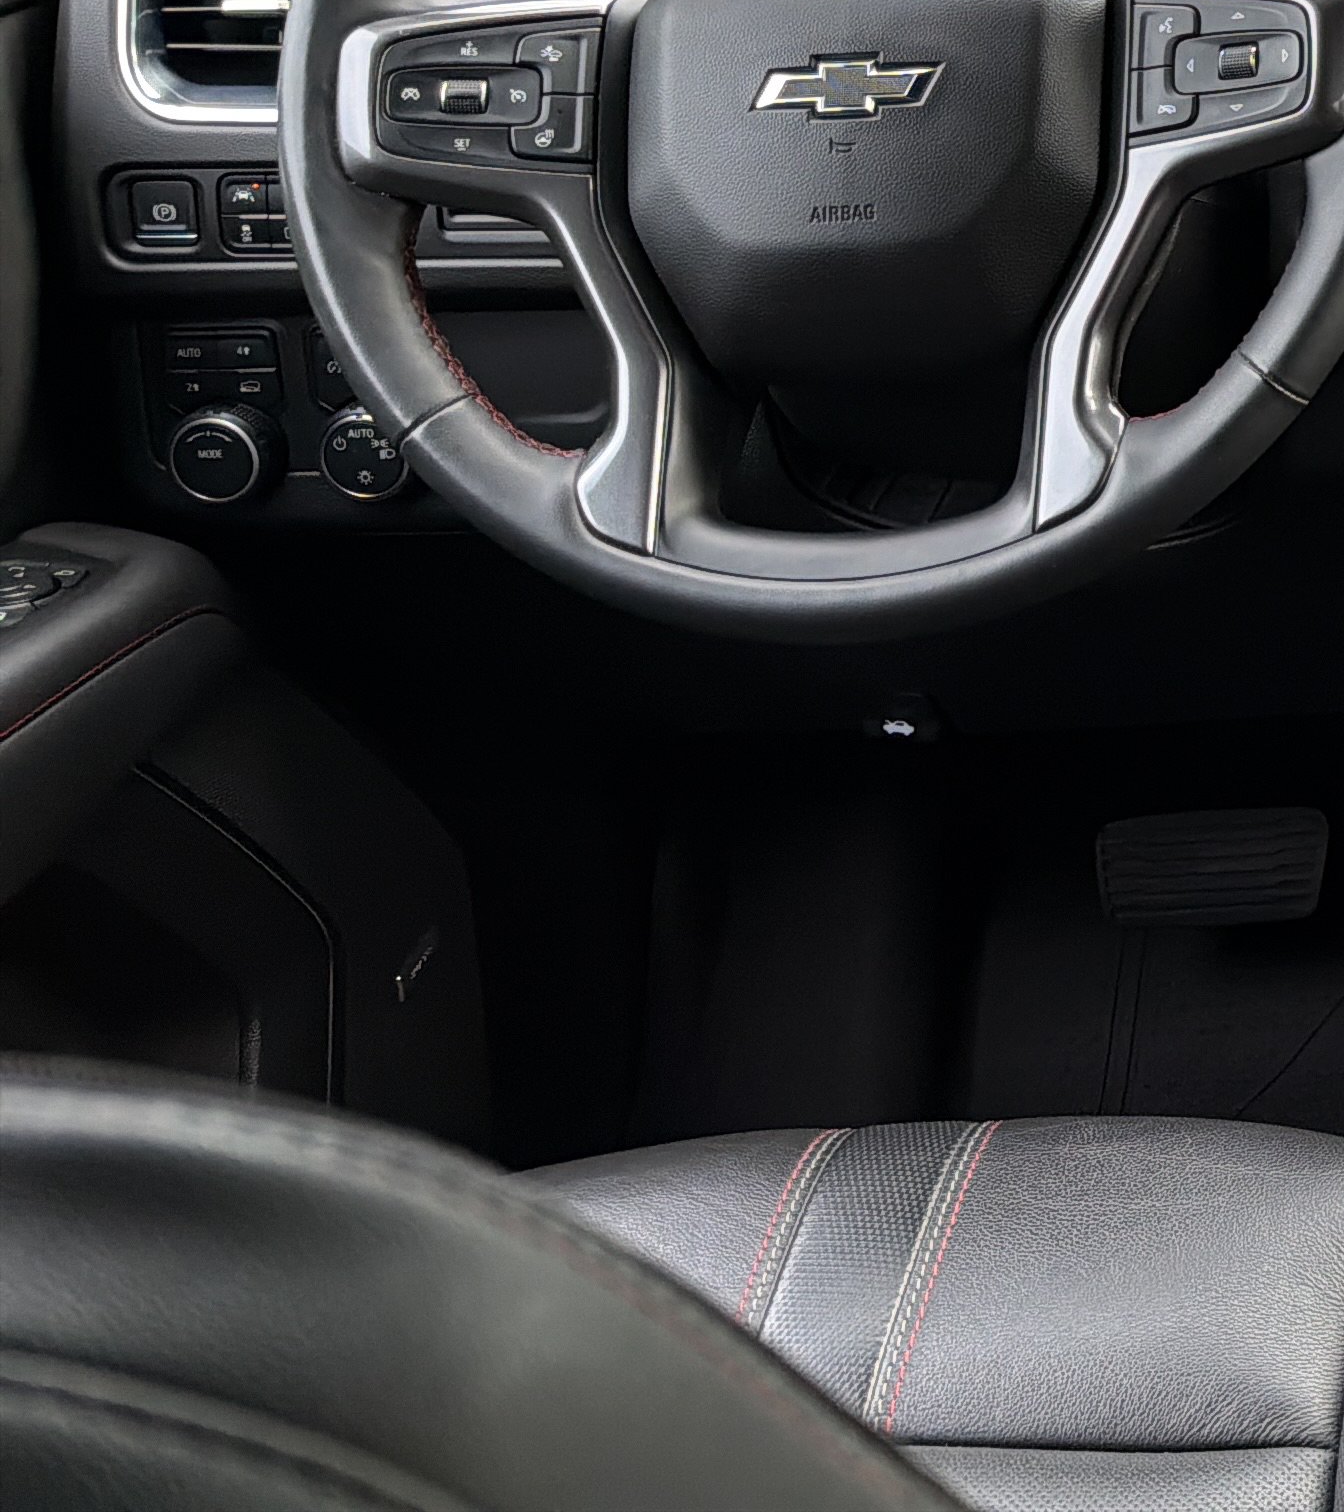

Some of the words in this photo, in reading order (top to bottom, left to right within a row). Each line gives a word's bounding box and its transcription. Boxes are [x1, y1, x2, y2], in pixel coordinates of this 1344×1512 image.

[461, 47, 478, 57] RES
[454, 140, 470, 148] SET
[810, 204, 877, 224] AIRBAG
[177, 348, 201, 358] AUTO
[347, 428, 374, 438] AUTO
[198, 450, 223, 459] MODE
